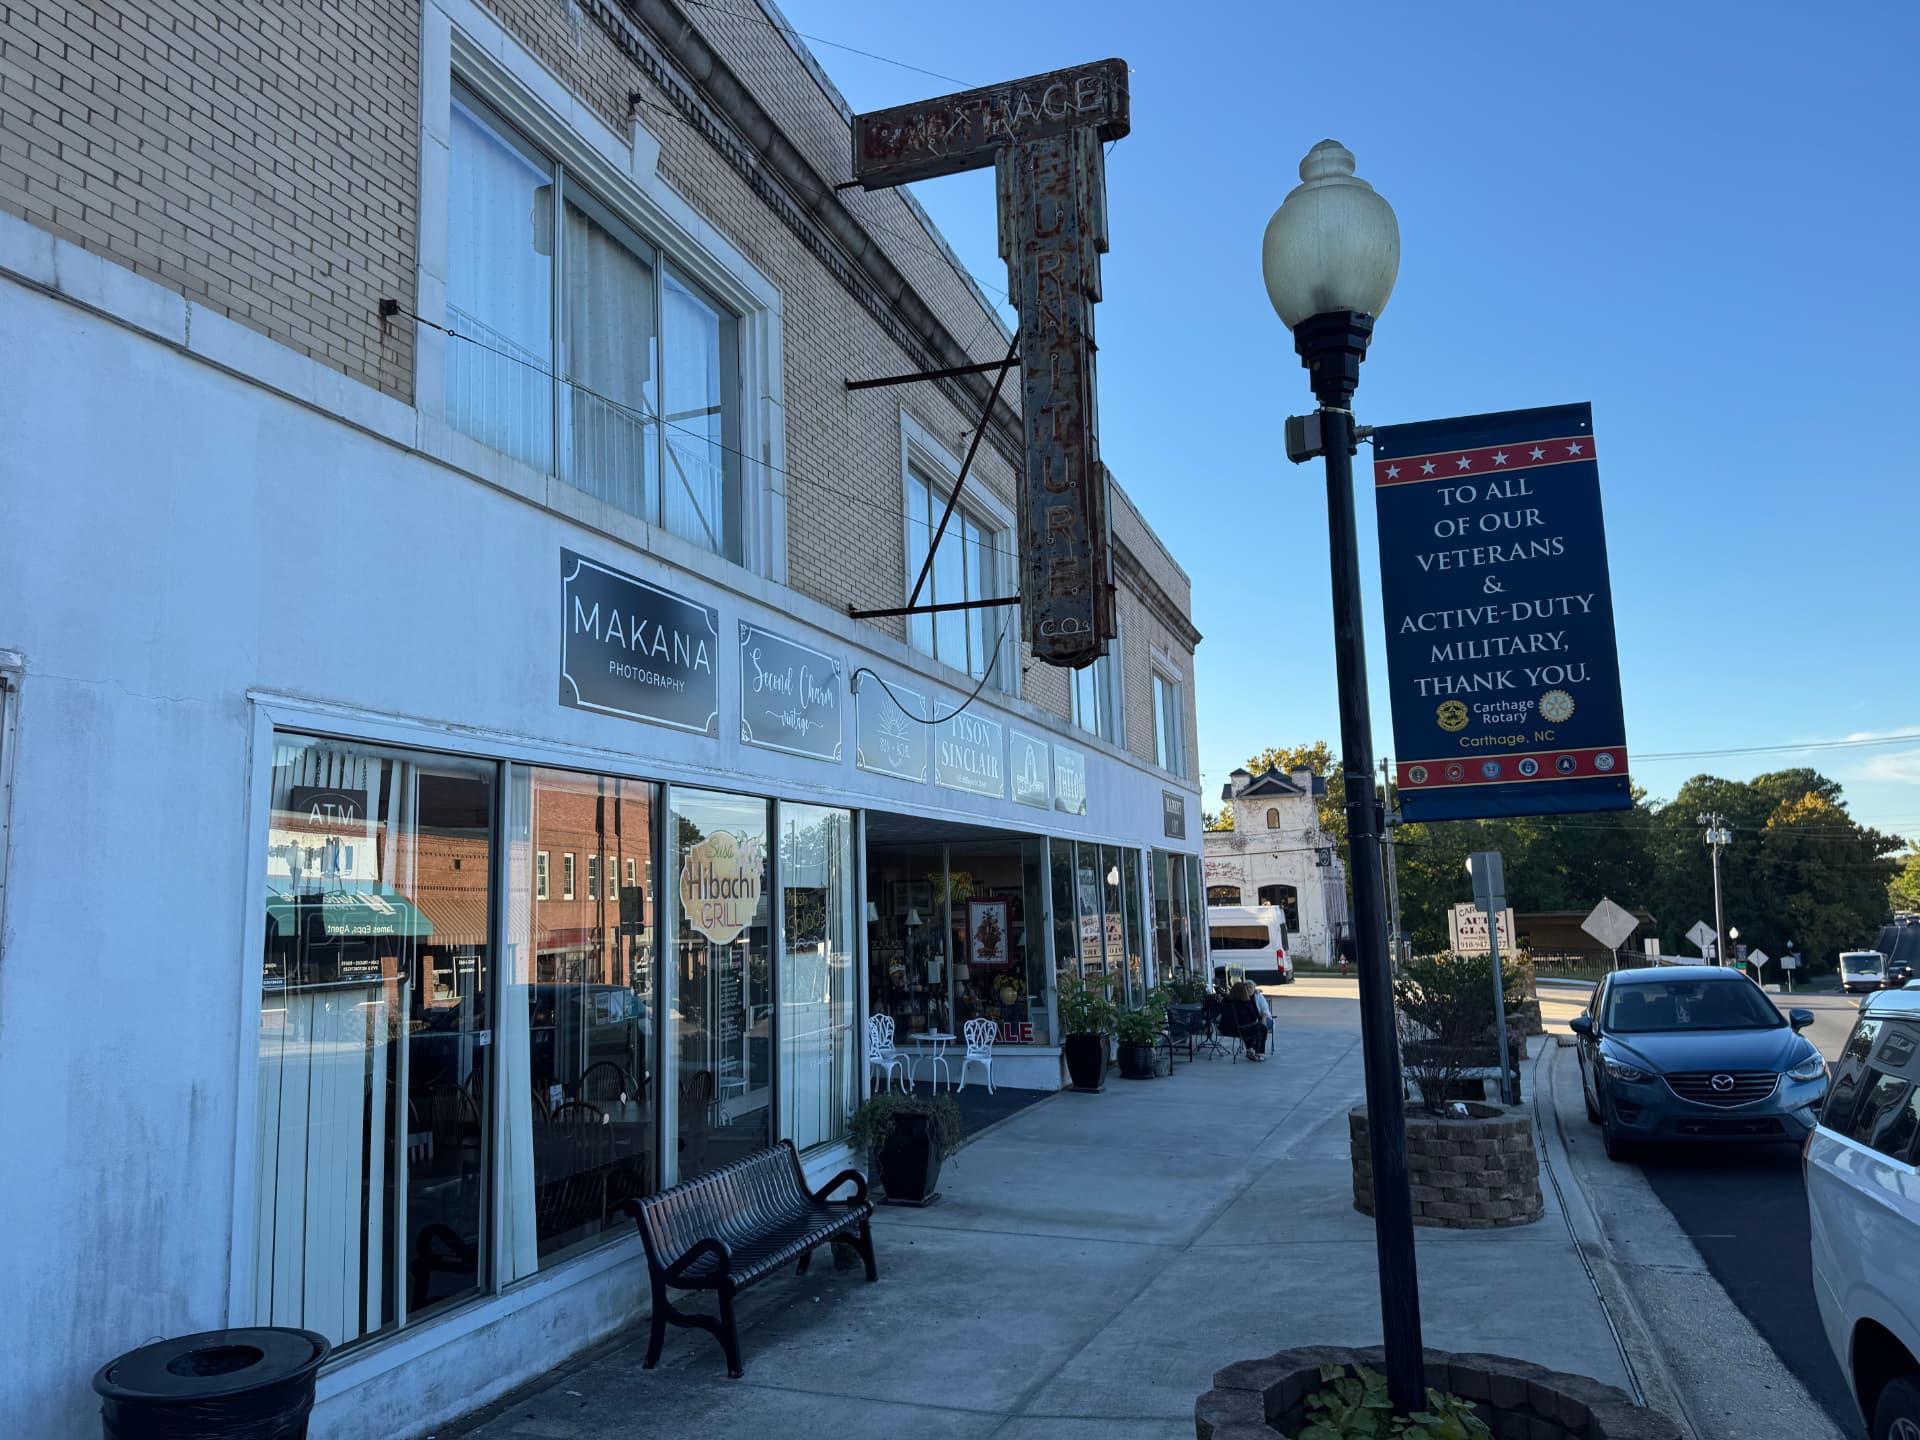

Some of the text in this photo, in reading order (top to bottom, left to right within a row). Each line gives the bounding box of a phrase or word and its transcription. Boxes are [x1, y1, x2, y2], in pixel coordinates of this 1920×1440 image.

[1437, 478, 1533, 506] TO ALL
[1434, 508, 1546, 538] OF OUR
[1416, 536, 1565, 572] VETERANS
[1483, 575, 1506, 594] &
[1399, 593, 1595, 634] ACTIVE-DUTY
[575, 595, 711, 675] MAKANA
[1430, 630, 1569, 663] MILITARY,
[609, 660, 685, 693] PHOTOGRAPHY
[749, 648, 834, 709] Second Charm
[1413, 662, 1591, 697] THANK YOU.
[1473, 700, 1535, 713] Carthage
[1482, 712, 1527, 724] Rotary
[951, 712, 992, 747] TYSON
[1459, 730, 1556, 747] Carthage, NC
[941, 740, 999, 779] SINCLAIR
[309, 803, 354, 826] ATM
[687, 861, 755, 900] Hibachi
[701, 902, 744, 929] GRILL
